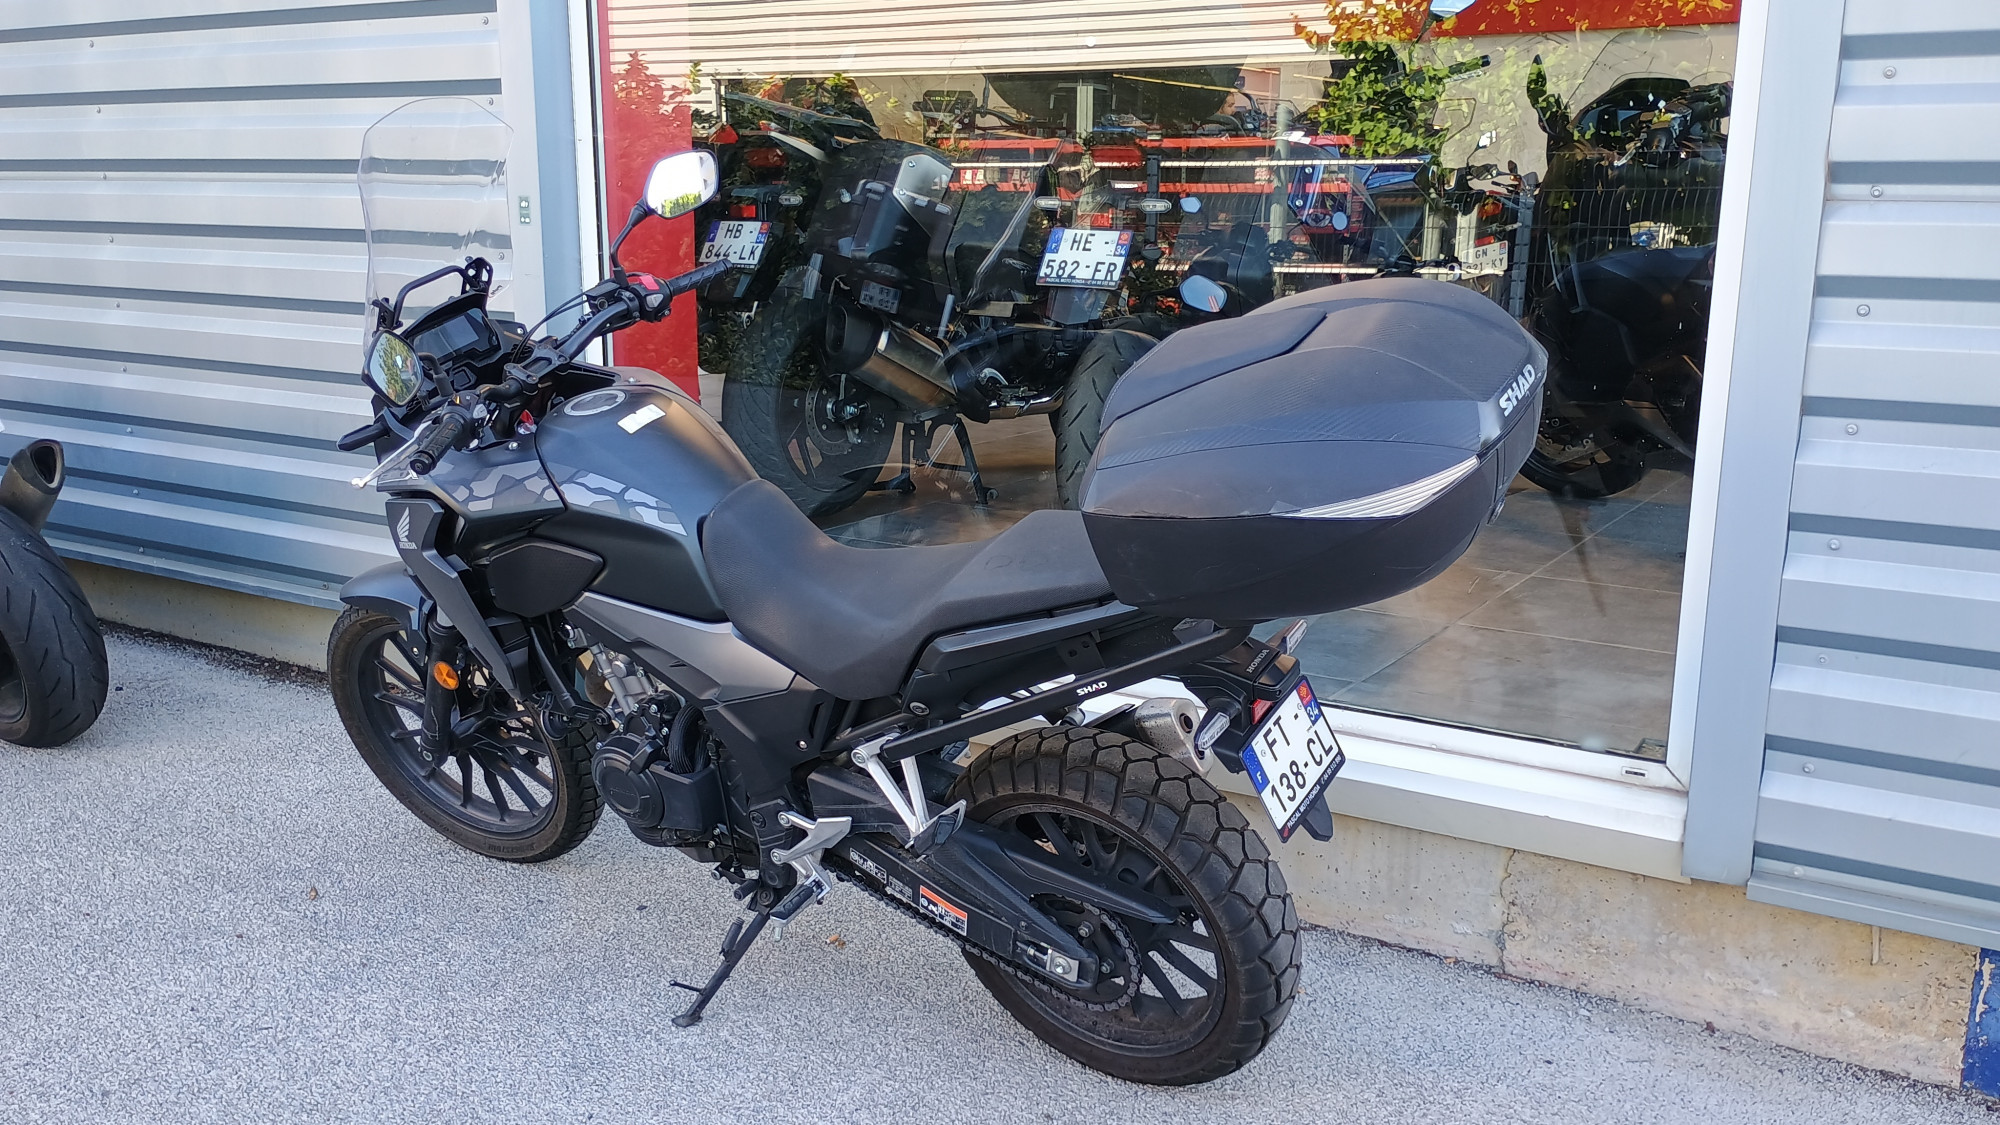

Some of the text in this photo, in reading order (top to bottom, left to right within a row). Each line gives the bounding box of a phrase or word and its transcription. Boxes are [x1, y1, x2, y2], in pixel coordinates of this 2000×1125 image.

[723, 223, 744, 239] HB
[1070, 232, 1096, 252] HE
[1115, 245, 1127, 255] 34
[704, 244, 760, 261] 844-LK
[1475, 248, 1488, 259] GN
[1044, 259, 1118, 281] 582-FR
[1499, 364, 1536, 417] SHAD
[1246, 648, 1270, 674] HONDA
[1076, 680, 1108, 696] SHAD
[1306, 701, 1320, 721] 34
[1262, 714, 1291, 762] FT
[1256, 772, 1263, 784] F
[1270, 729, 1334, 813] 138-CL
[1286, 808, 1301, 829] PASCAL
[1299, 796, 1310, 814] MOTO
[1308, 785, 1321, 802] HONDA
